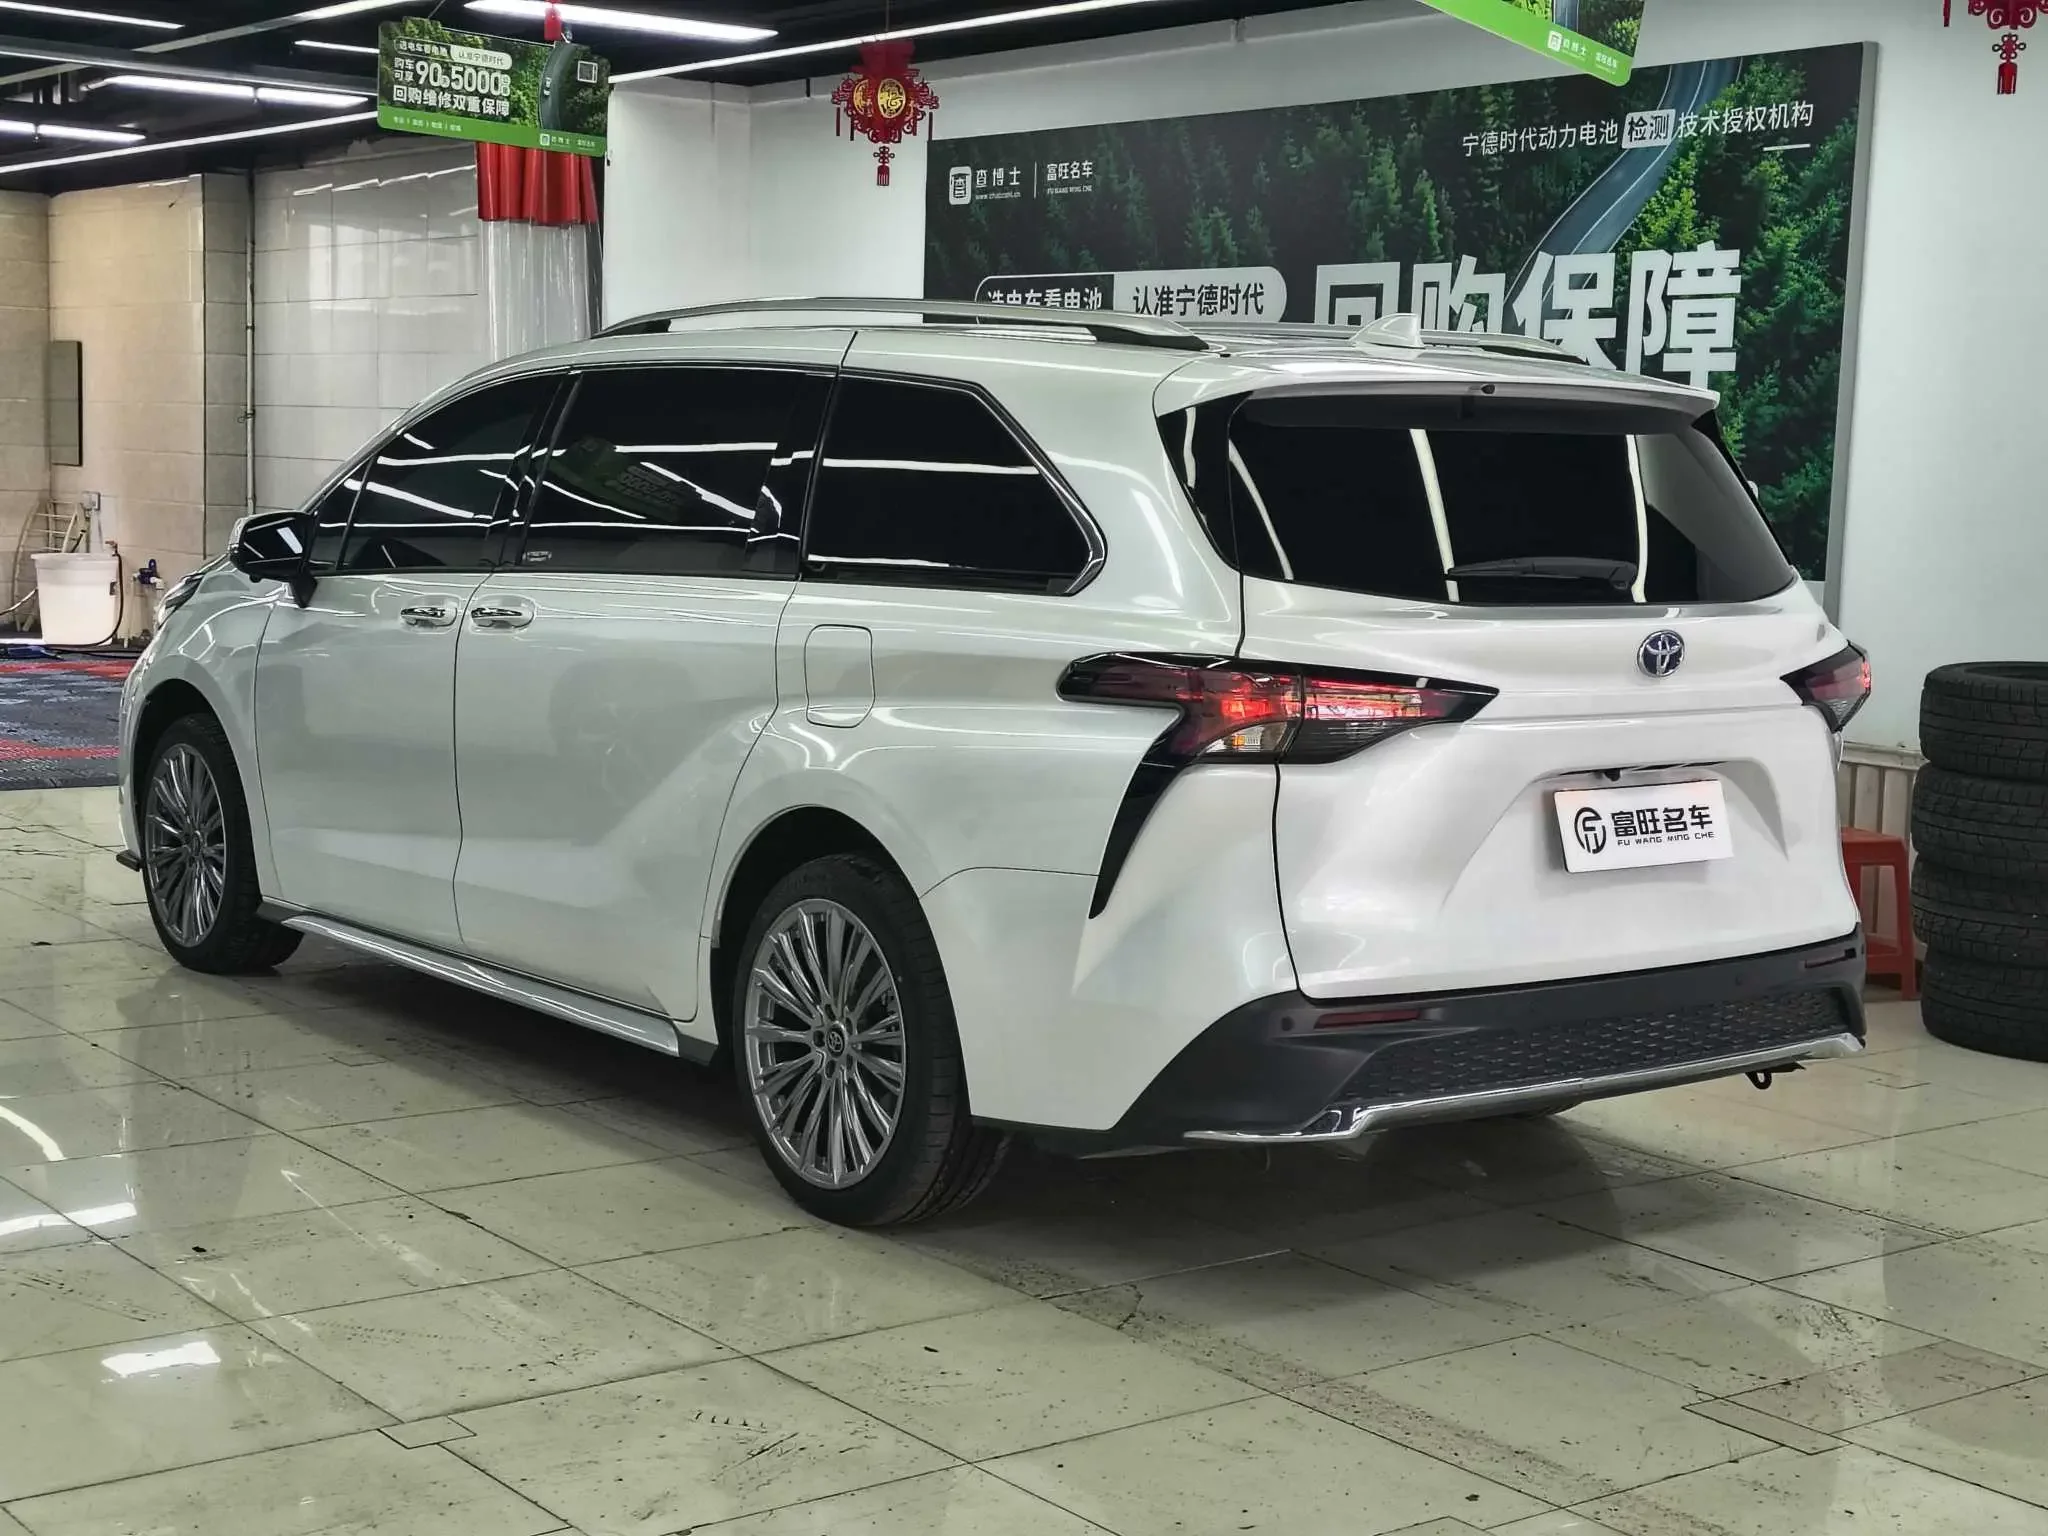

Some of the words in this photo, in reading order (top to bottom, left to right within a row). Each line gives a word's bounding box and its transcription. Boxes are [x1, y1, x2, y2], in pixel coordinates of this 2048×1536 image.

[393, 84, 510, 117] 回购维修双重保障
[976, 166, 1021, 188] 查博士
[1047, 160, 1093, 181] 富旺名车
[1132, 282, 1265, 316] 认准宁德时代
[1611, 805, 1713, 838] 富旺名车
[1617, 838, 1631, 846] FU
[1635, 836, 1663, 845] WANG
[1667, 833, 1690, 842] MING
[1694, 831, 1715, 840] CHE
